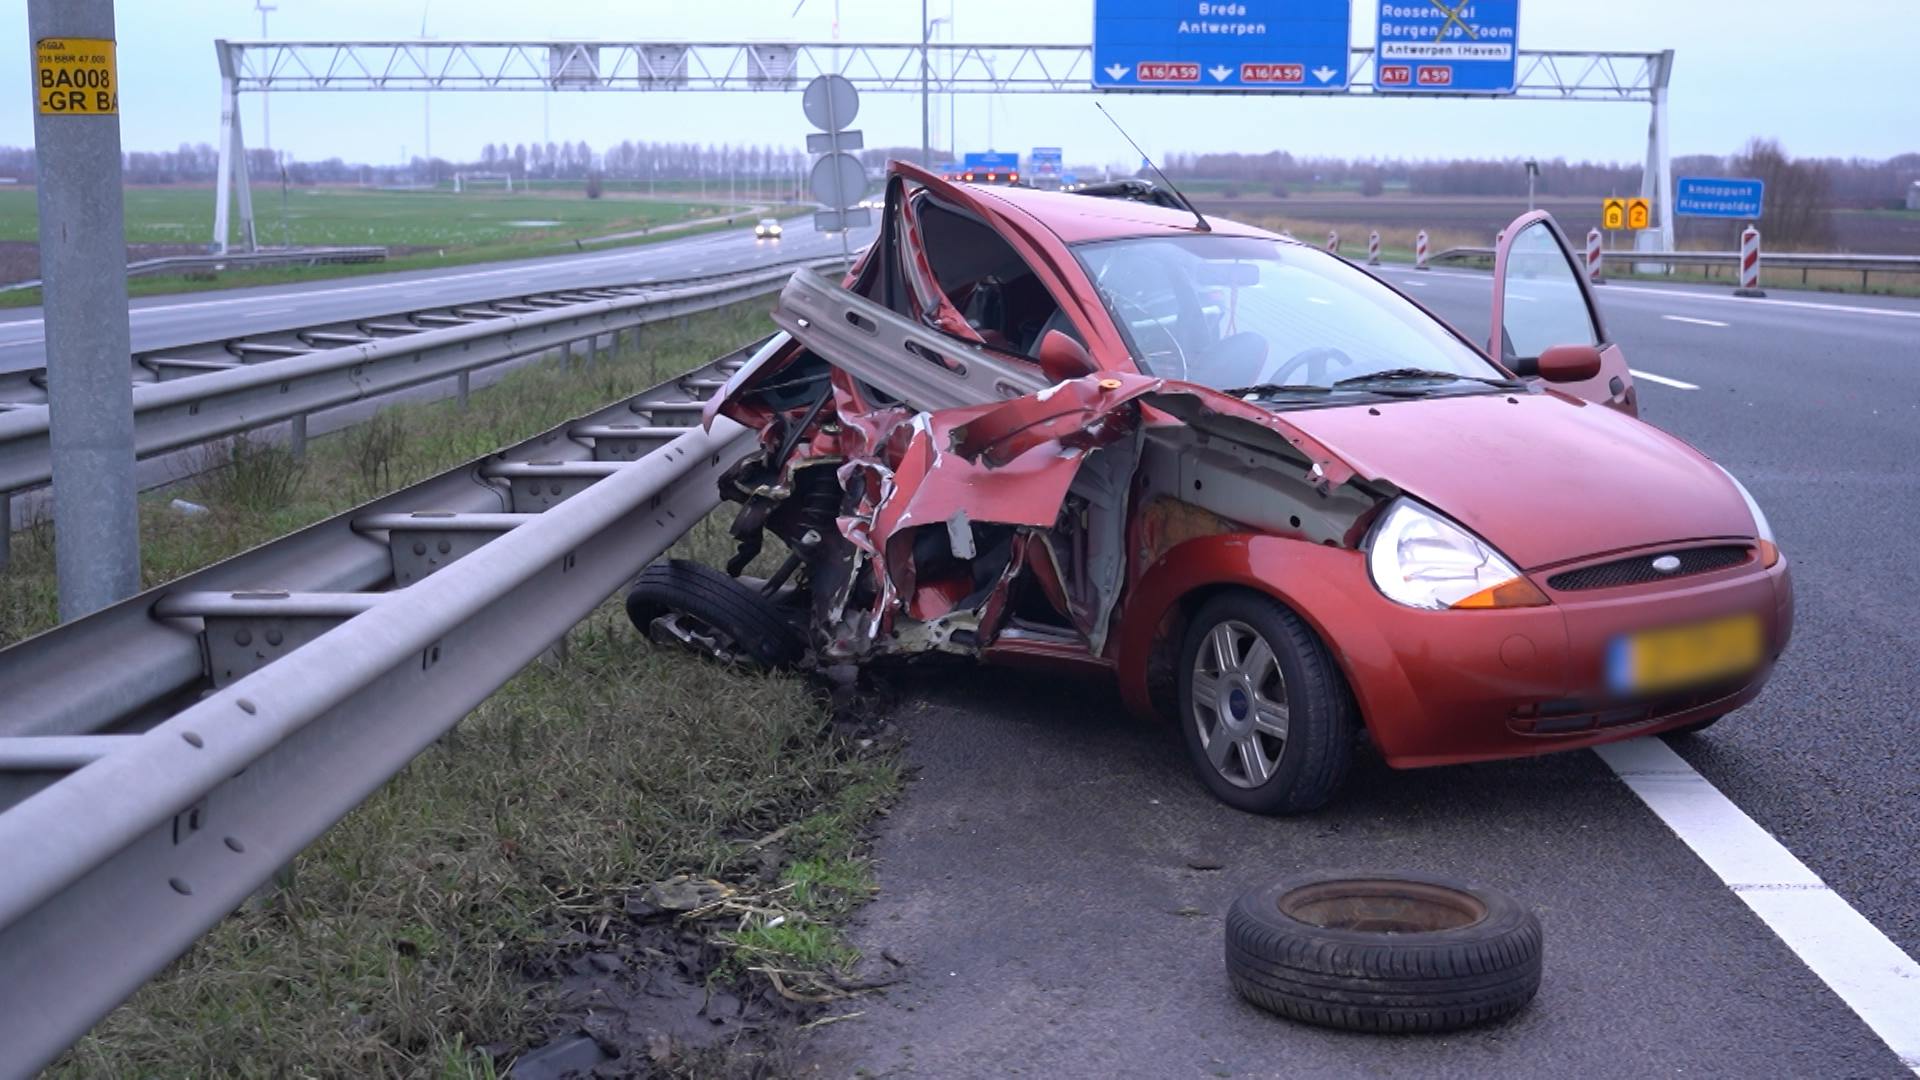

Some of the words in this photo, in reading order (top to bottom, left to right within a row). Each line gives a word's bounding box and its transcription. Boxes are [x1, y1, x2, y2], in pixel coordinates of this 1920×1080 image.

[1199, 3, 1247, 16] Breda
[1381, 5, 1476, 18] Roosenal
[1178, 21, 1267, 36] Antwerpen
[1381, 23, 1439, 39] Bergen
[1470, 24, 1513, 38] Zoom
[1385, 45, 1454, 57] Antwerpen
[1458, 46, 1508, 57] (Haven)
[41, 69, 110, 88] BA008
[43, 91, 87, 111] -GR
[1680, 199, 1758, 213] Klaverpolder
